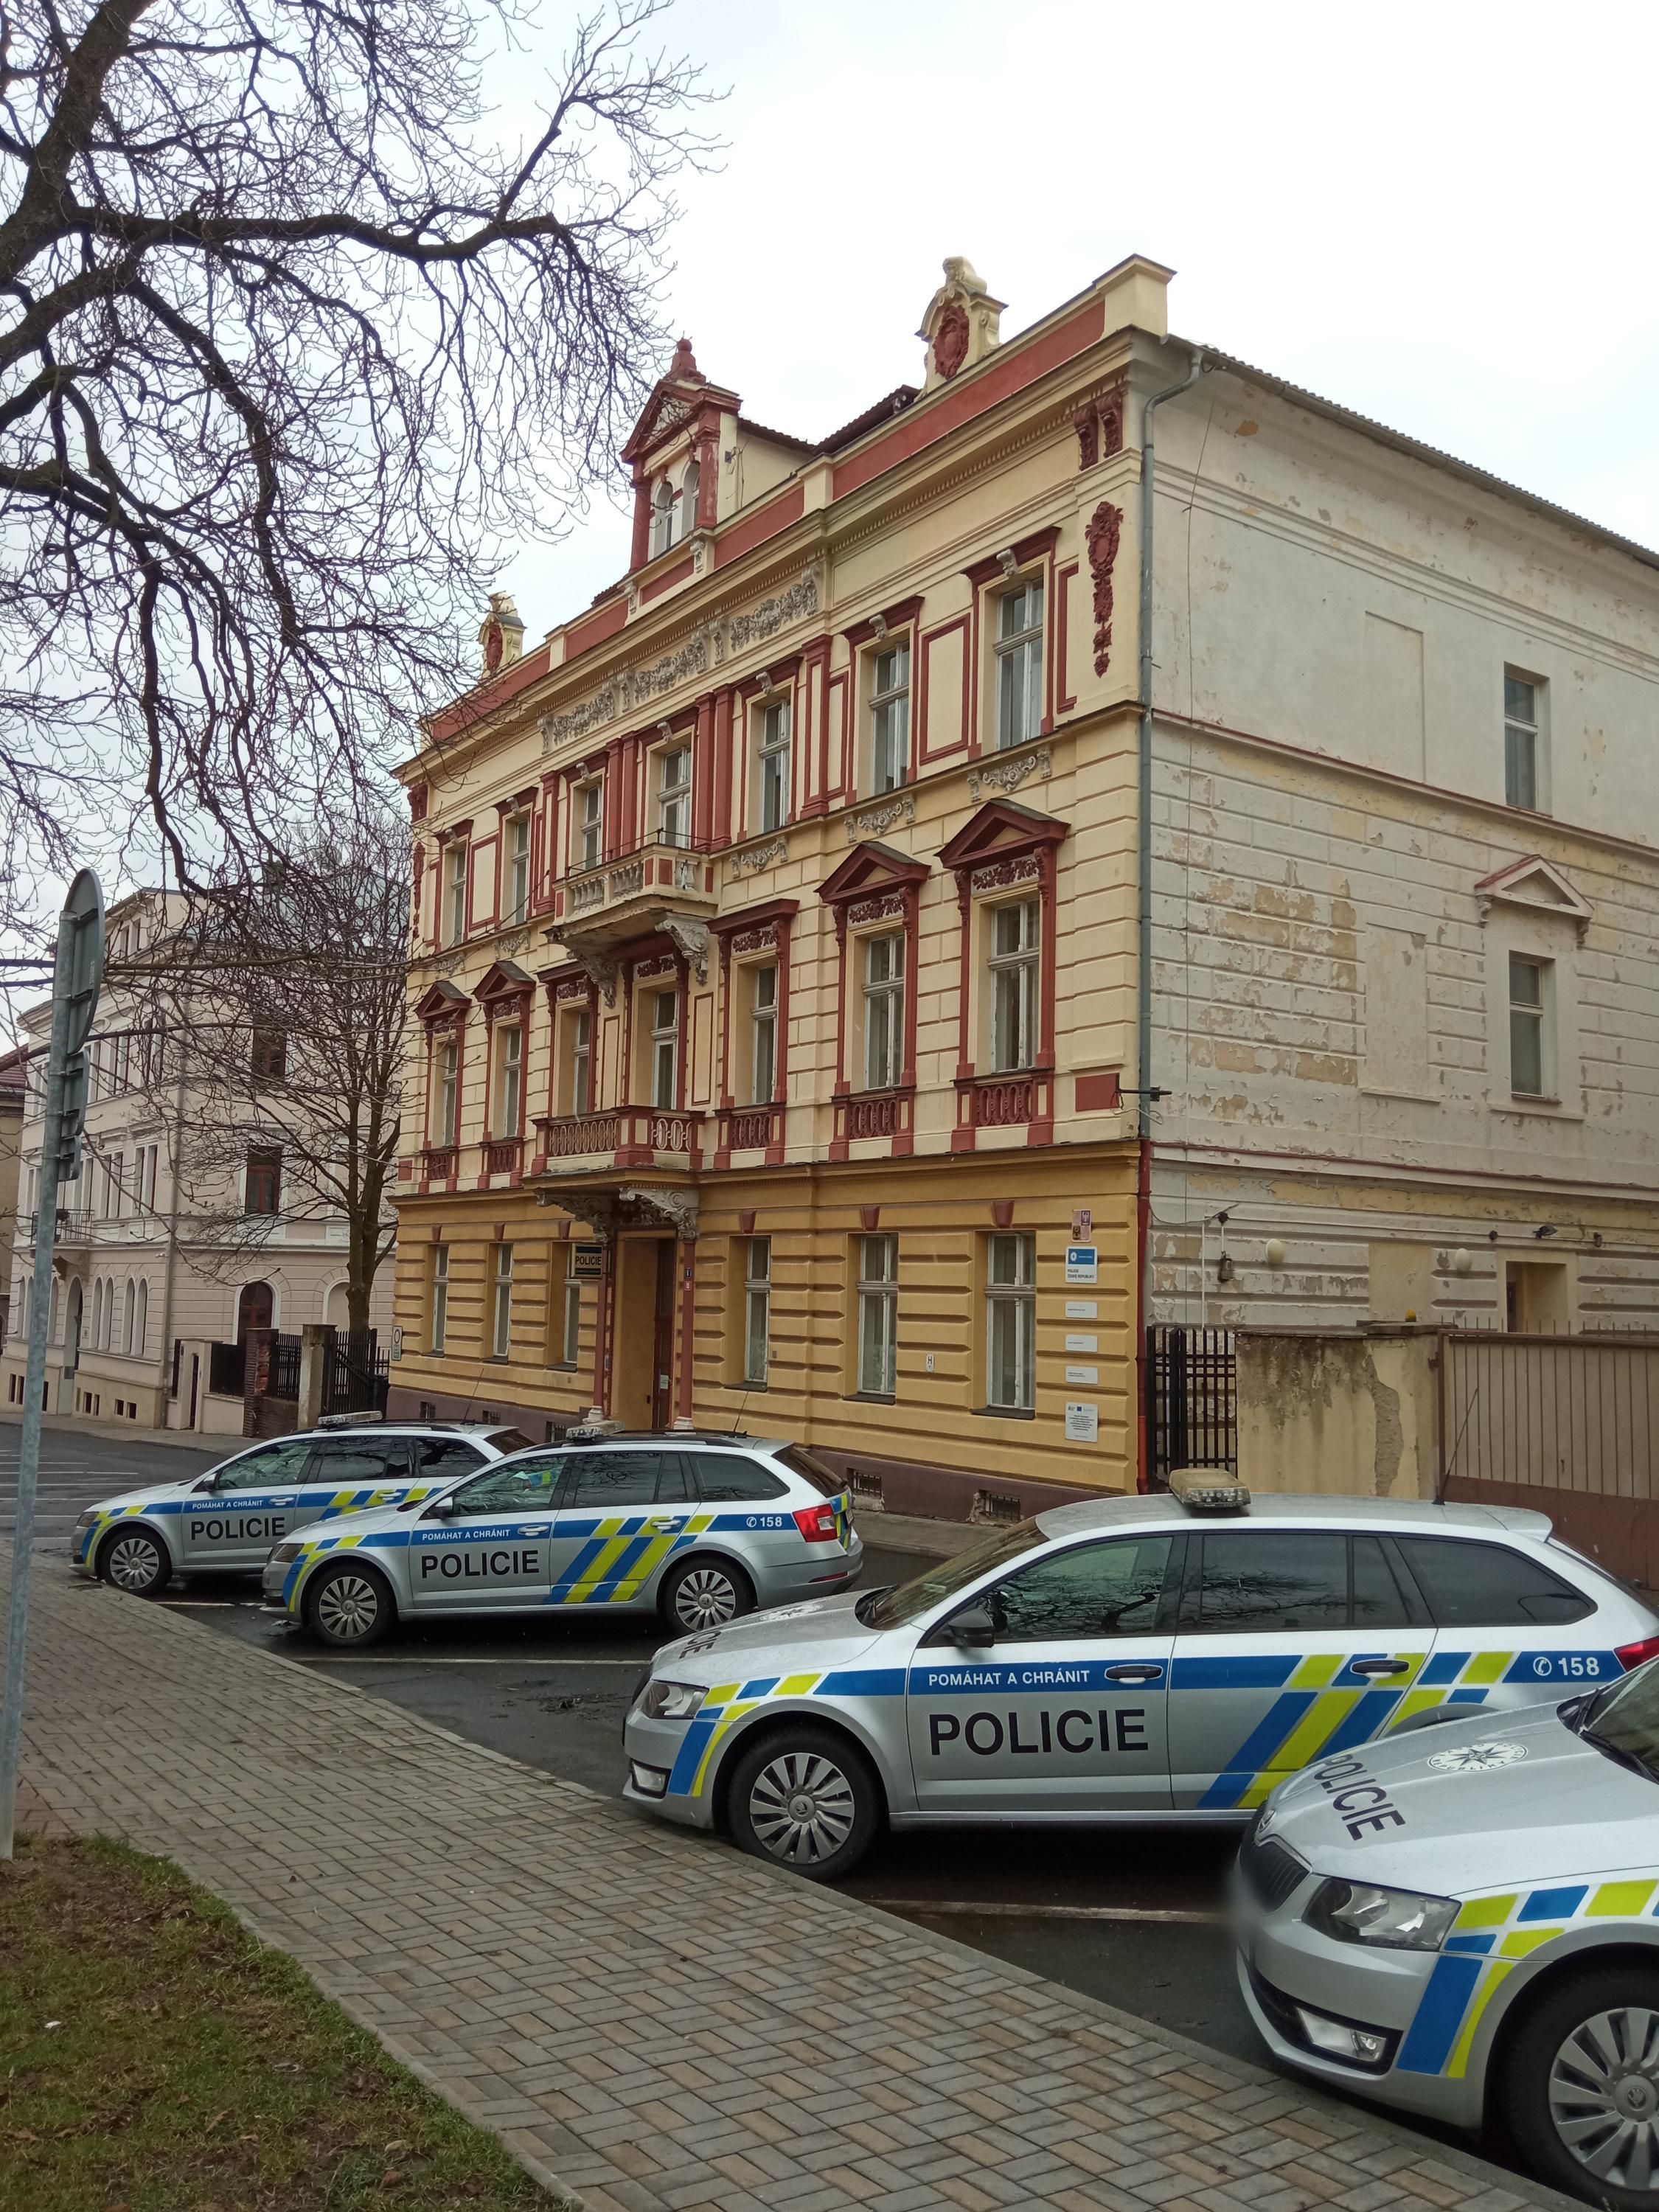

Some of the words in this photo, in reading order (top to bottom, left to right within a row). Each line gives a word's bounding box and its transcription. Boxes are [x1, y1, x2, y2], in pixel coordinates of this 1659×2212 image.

[575, 1256, 602, 1265] POLICIE
[191, 1517, 285, 1540] POLICIE
[759, 1516, 782, 1527] 158
[422, 1531, 462, 1540] POMÁHAT
[473, 1528, 510, 1538] CHRÁNIT
[421, 1550, 540, 1579] POLICIE
[1558, 1657, 1600, 1676] 158
[928, 1670, 1001, 1686] POMÁHAT
[1007, 1672, 1018, 1684] A
[1022, 1667, 1090, 1684] CHRÁNIT
[929, 1708, 1149, 1756] POLICIE
[1314, 1754, 1406, 1841] POLICIE
